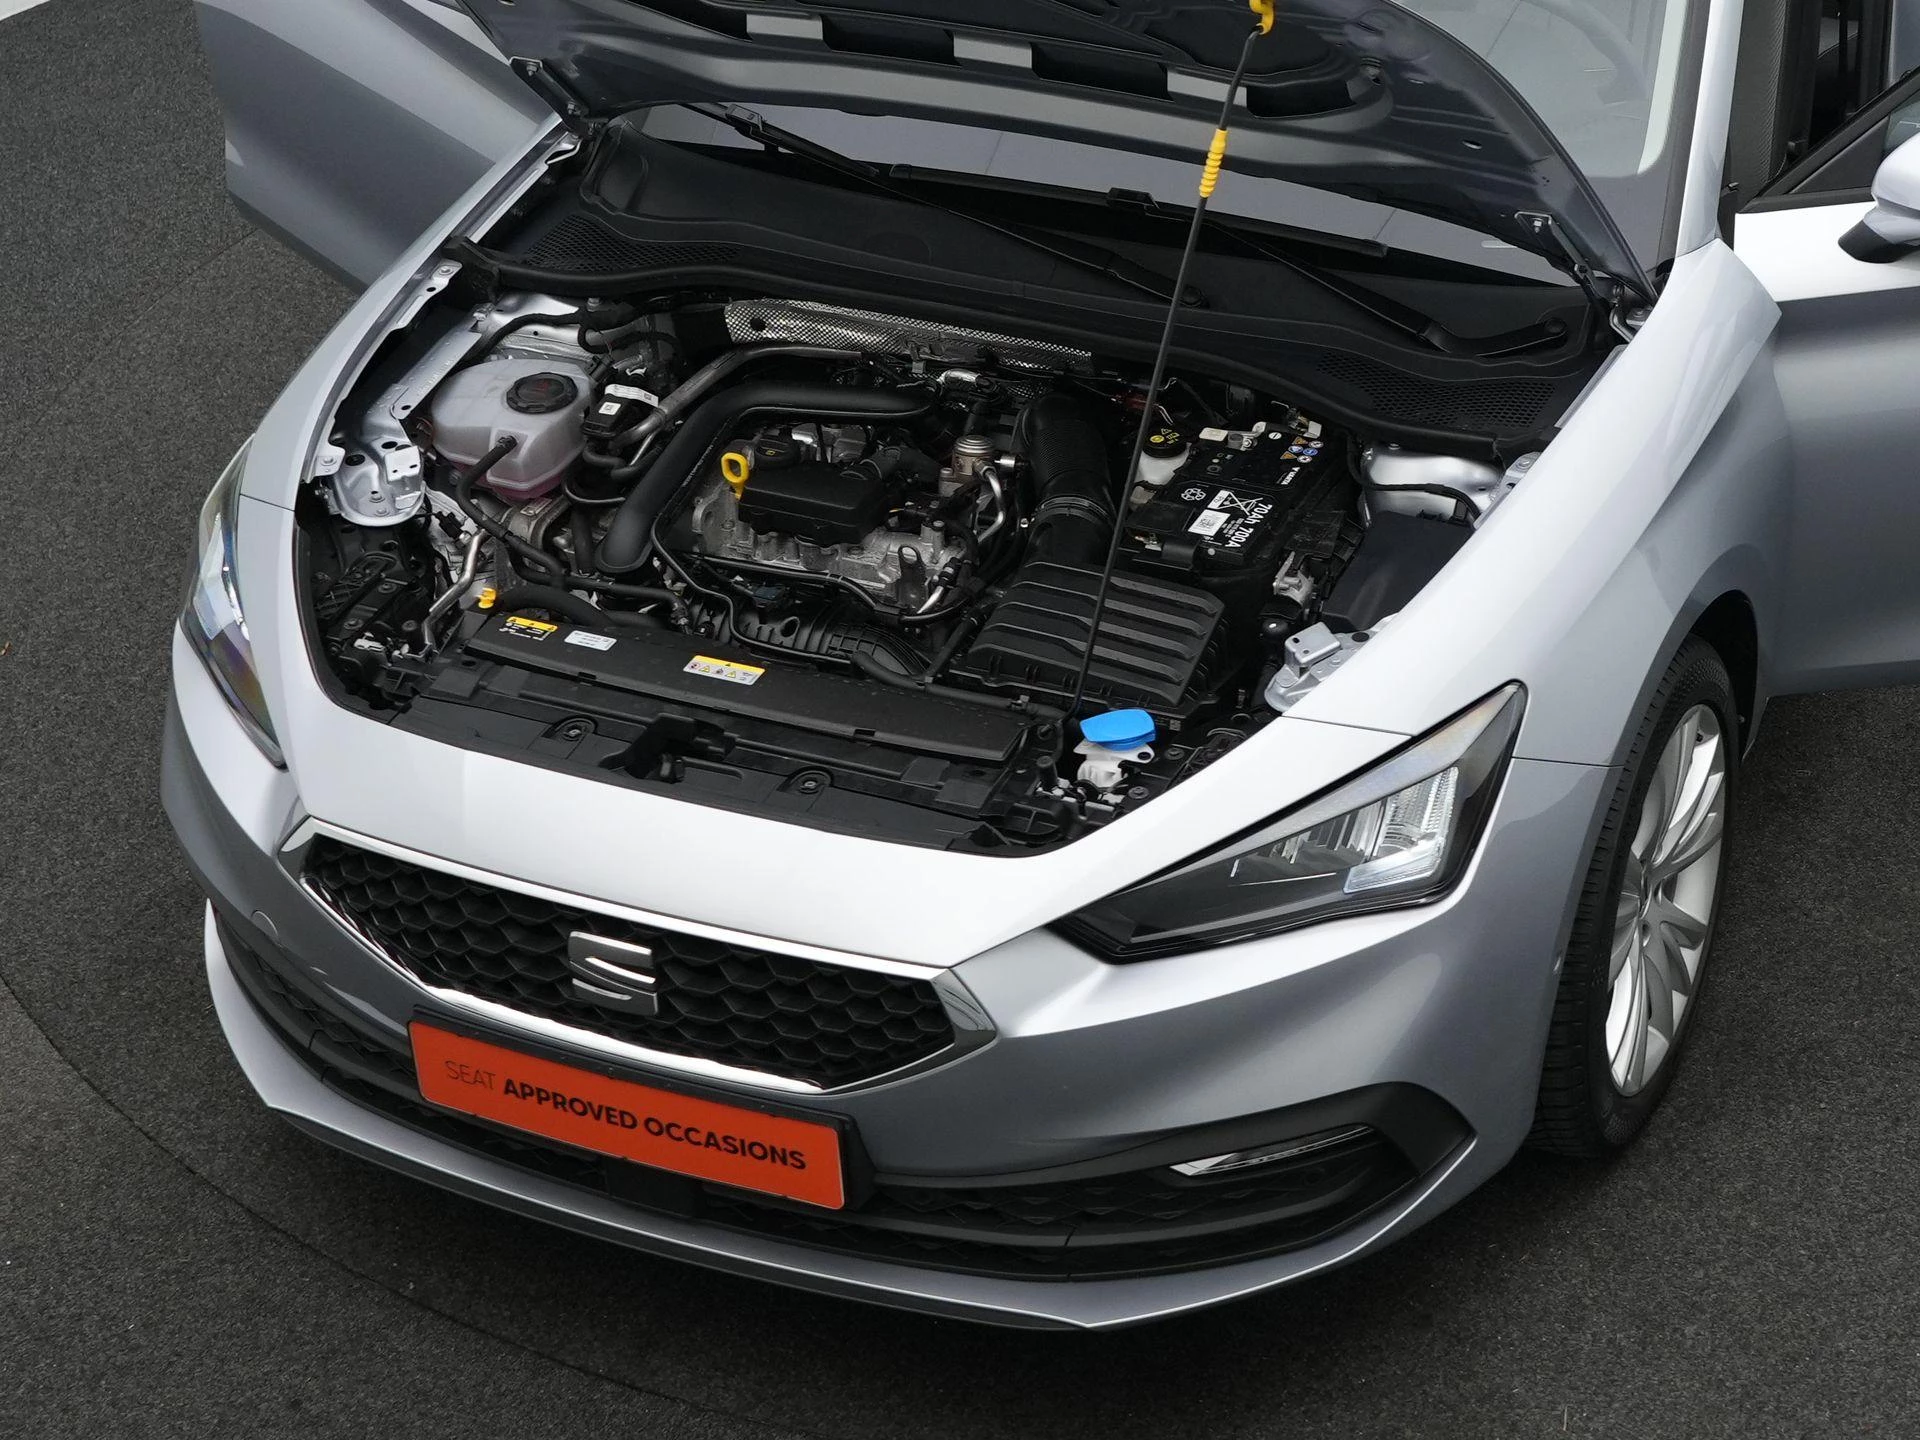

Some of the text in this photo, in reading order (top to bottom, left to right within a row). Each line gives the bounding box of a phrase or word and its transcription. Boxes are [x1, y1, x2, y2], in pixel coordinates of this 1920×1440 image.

[1244, 503, 1273, 524] 70Ah
[1225, 527, 1254, 547] 700A
[446, 1061, 807, 1169] SEAT APPROVED OCCASIONS
